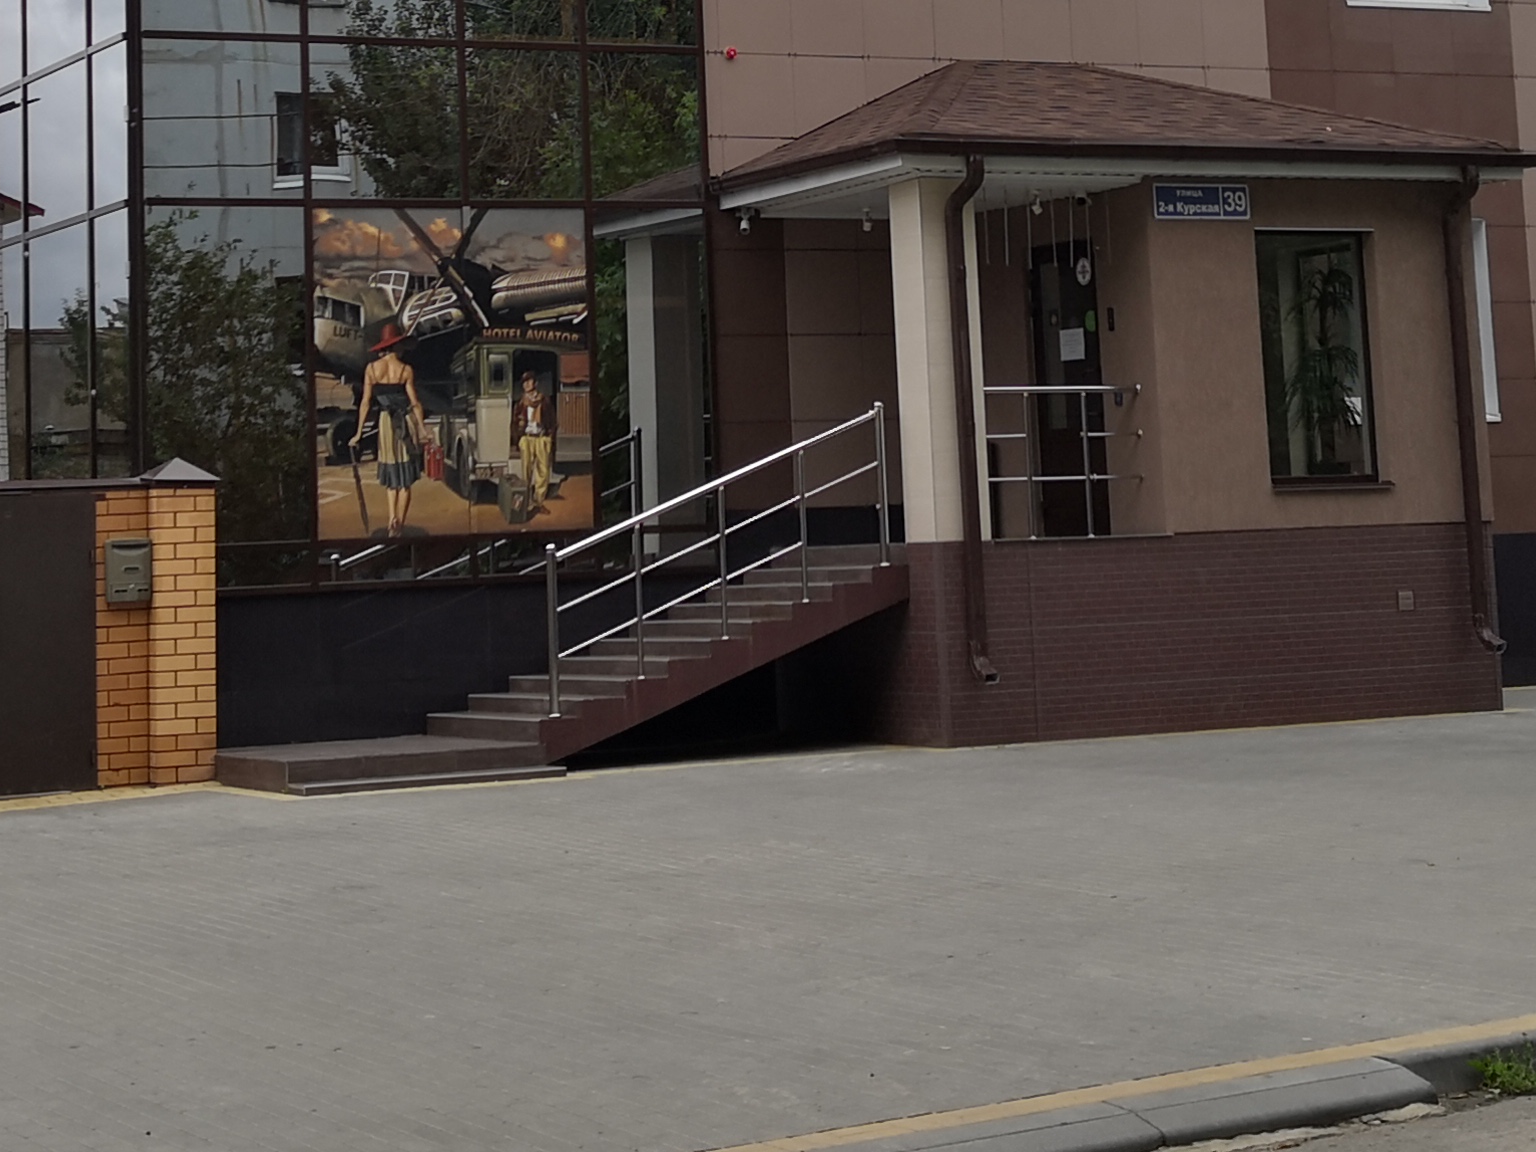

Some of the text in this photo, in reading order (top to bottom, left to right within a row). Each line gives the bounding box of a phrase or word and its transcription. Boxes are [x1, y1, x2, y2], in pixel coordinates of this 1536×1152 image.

[1158, 201, 1220, 215] 2-я Курская
[1223, 191, 1246, 212] 39
[482, 328, 580, 342] HOTEL AVIATOR
